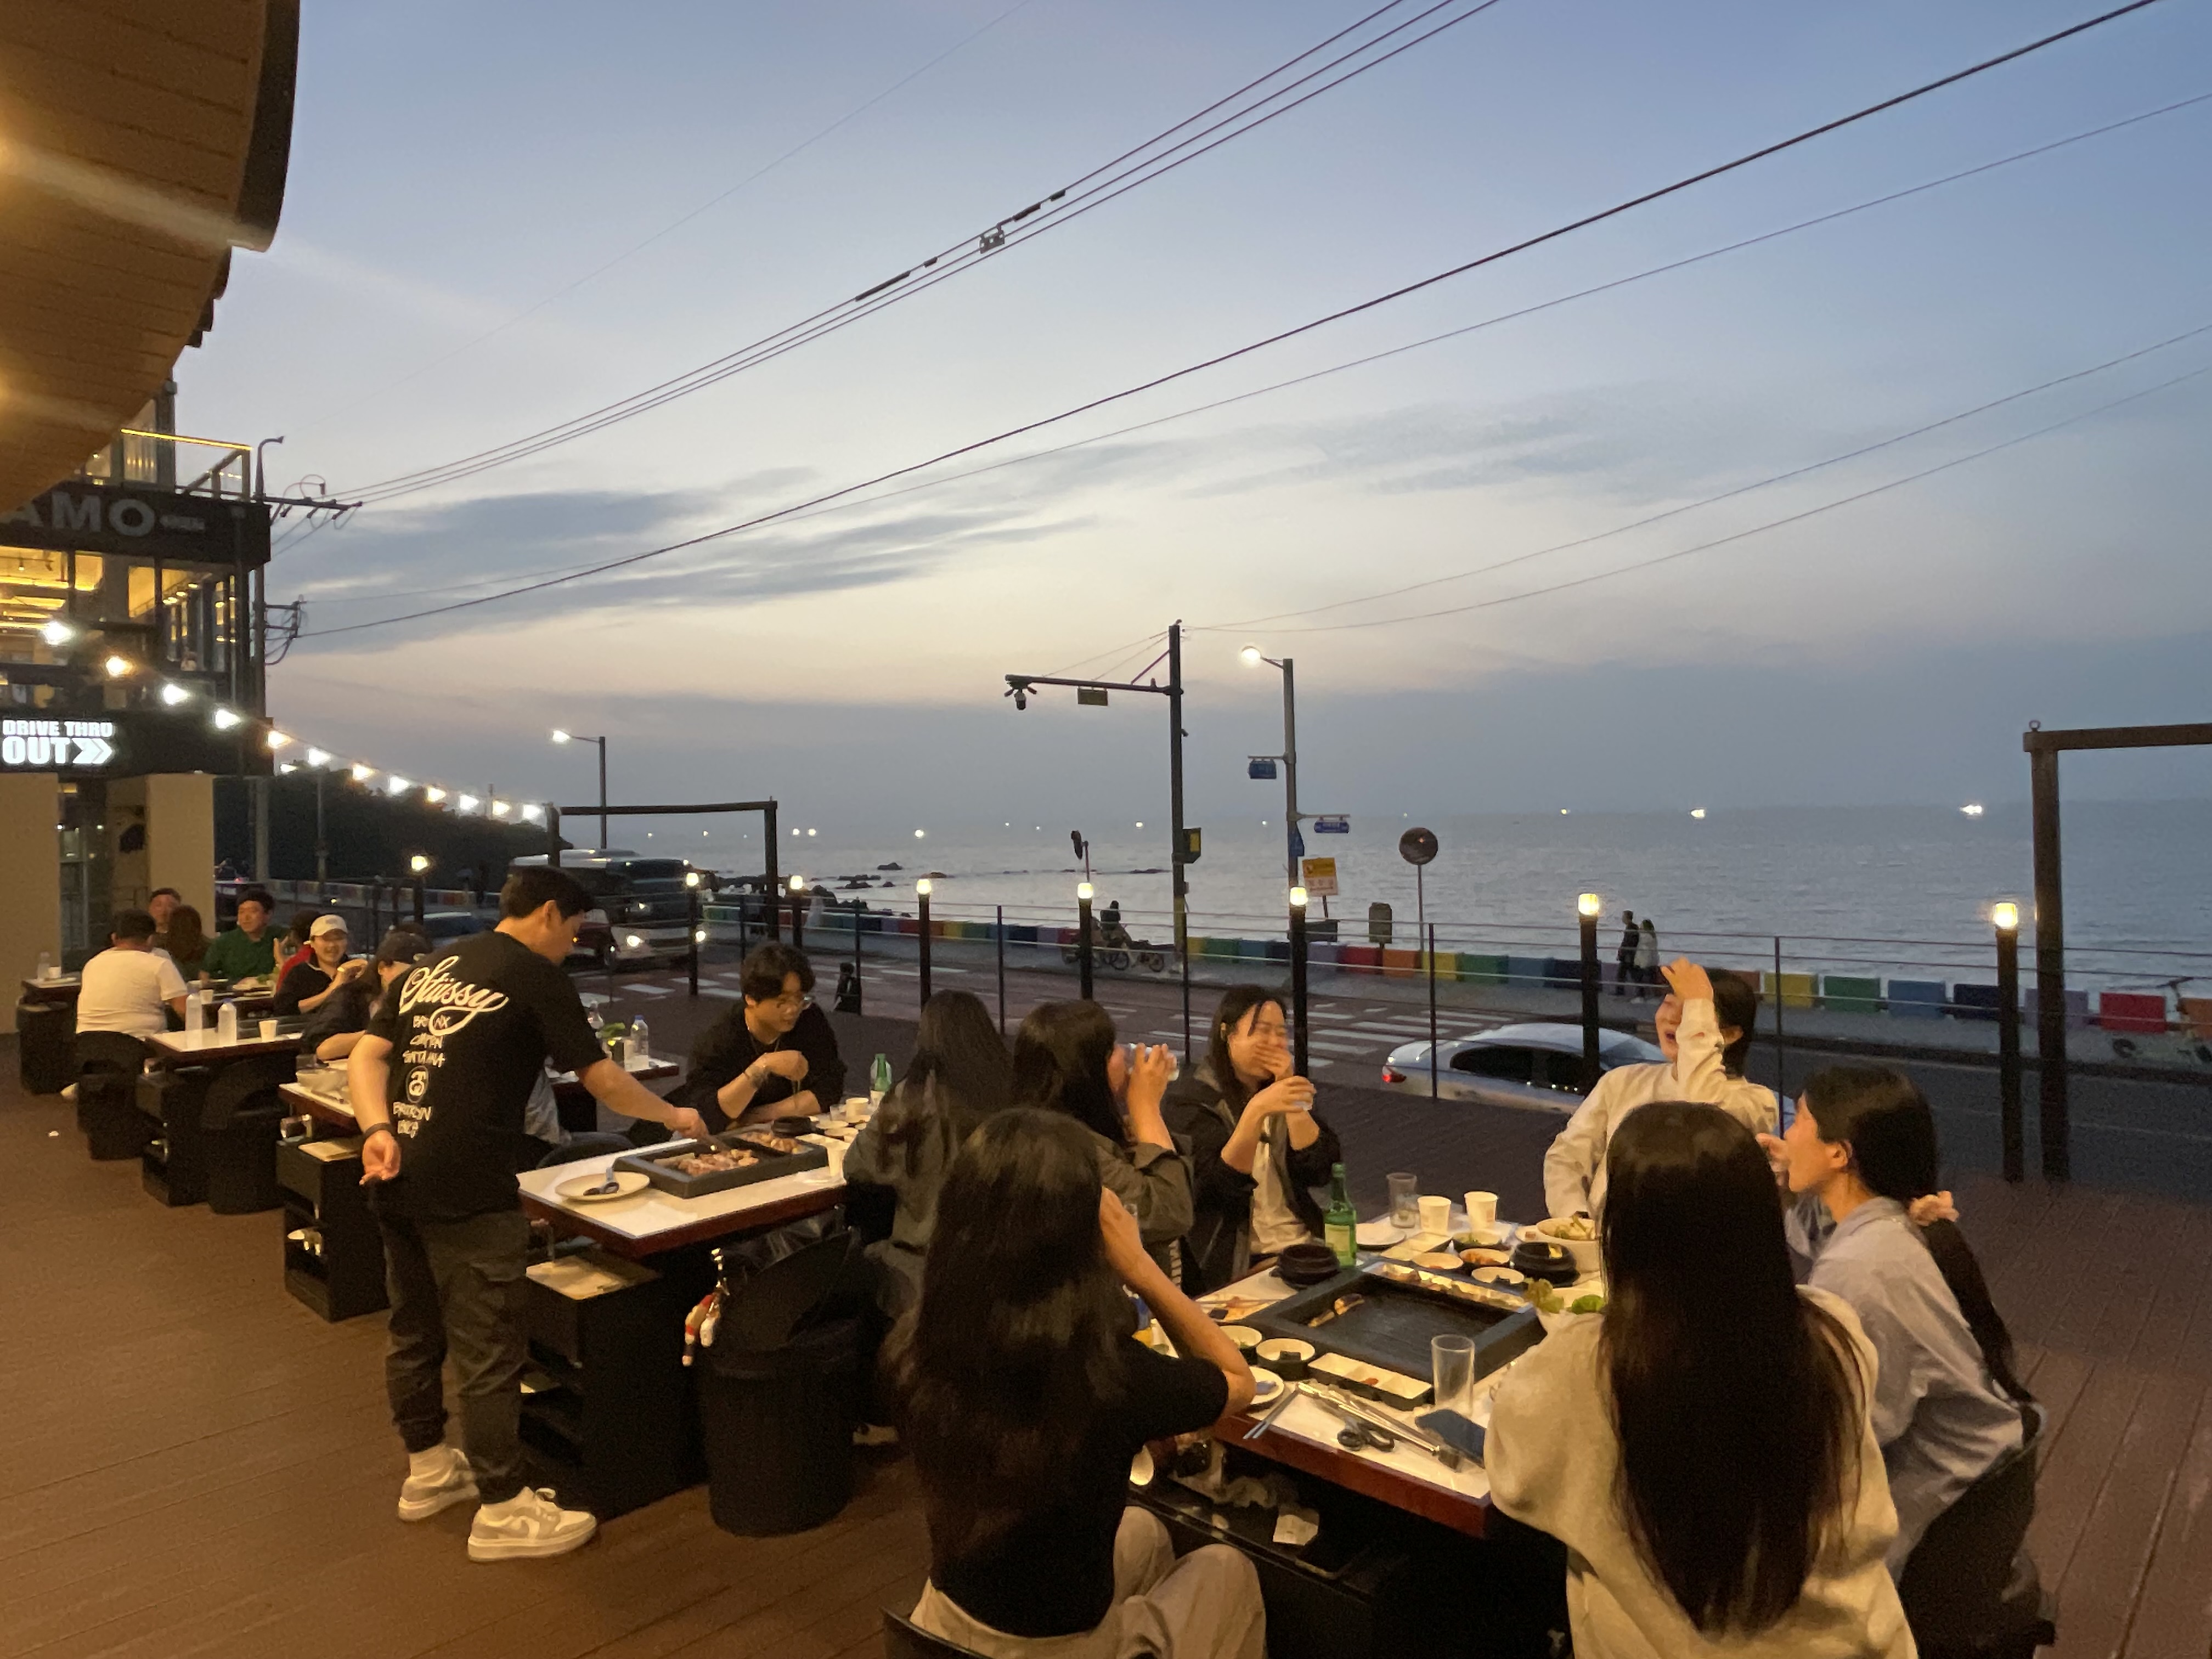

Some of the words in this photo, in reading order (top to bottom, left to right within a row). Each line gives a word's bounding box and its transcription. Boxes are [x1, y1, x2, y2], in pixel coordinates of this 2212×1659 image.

[3, 720, 59, 736] DRIVE
[64, 721, 114, 737] THRU
[2, 736, 70, 764] OUT
